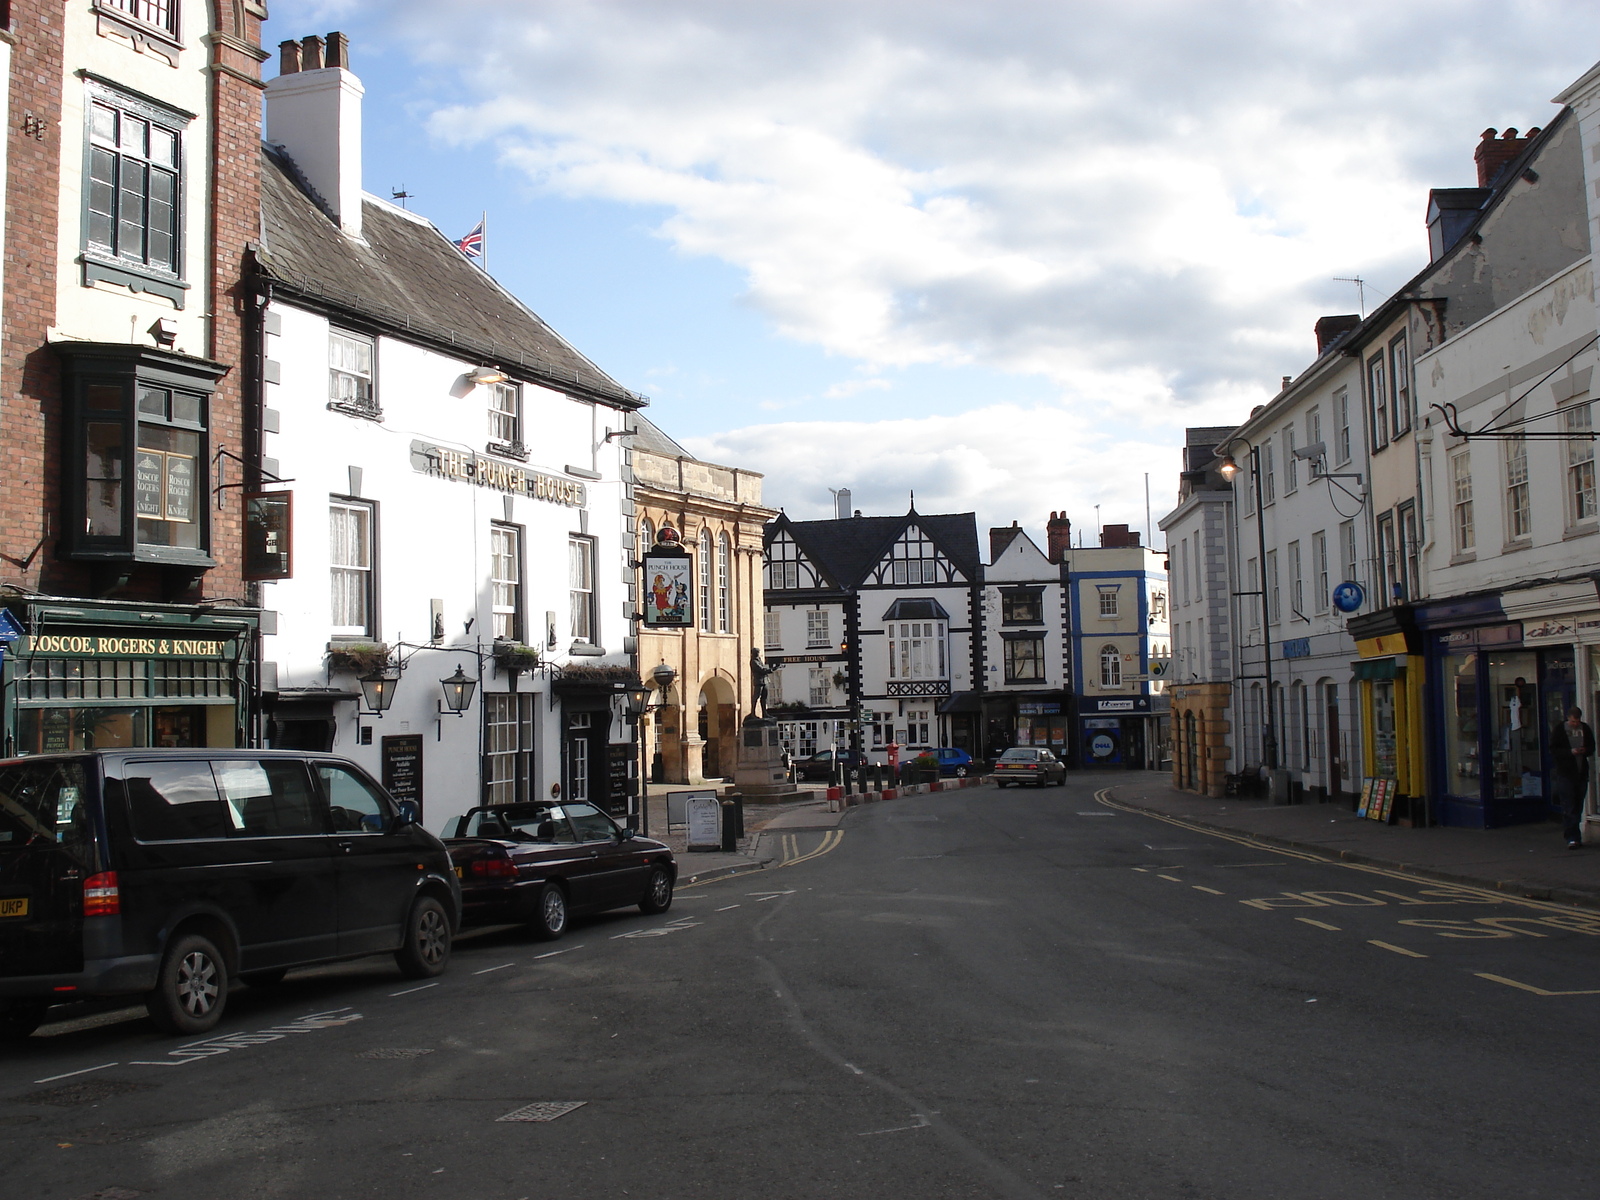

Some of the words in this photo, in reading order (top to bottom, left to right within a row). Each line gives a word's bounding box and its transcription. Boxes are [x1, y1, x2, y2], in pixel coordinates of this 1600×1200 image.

[438, 449, 469, 478] THE
[477, 459, 526, 492] PUNCH
[536, 474, 582, 505] HOUSE
[1526, 621, 1571, 637] calico
[28, 636, 95, 656] ROSCOE,
[98, 638, 155, 654] ROGERS
[158, 640, 170, 654] &
[172, 640, 225, 655] KNIGHT
[2, 900, 22, 914] UKP
[1239, 889, 1504, 910] STOP
[127, 1012, 364, 1066] LOADING
